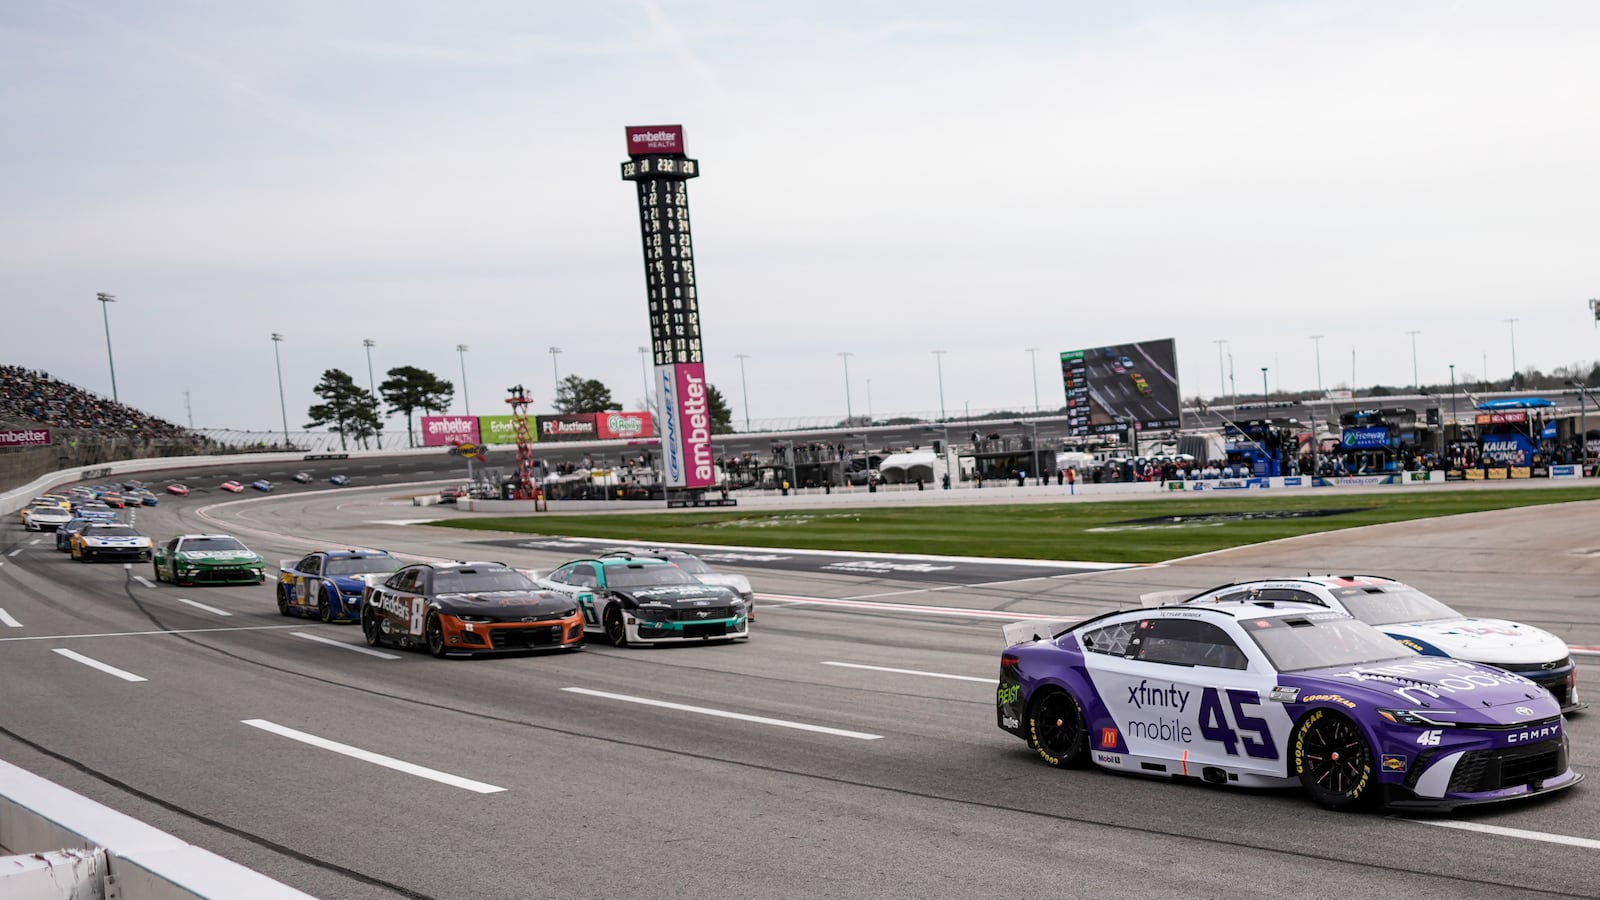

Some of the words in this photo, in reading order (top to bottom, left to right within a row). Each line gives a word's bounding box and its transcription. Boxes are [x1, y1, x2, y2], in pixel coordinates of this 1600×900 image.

[632, 131, 676, 142] ambetter
[624, 162, 635, 176] 232
[658, 158, 673, 172] 232
[666, 182, 670, 191] 1
[679, 181, 685, 194] 2
[665, 194, 672, 203] 2
[675, 193, 686, 206] 22
[667, 208, 673, 218] 3
[677, 207, 688, 219] 21
[668, 219, 674, 230] 4
[670, 234, 676, 244] 5
[679, 234, 690, 246] 23
[681, 246, 691, 258] 24
[672, 261, 678, 270] 7
[682, 260, 693, 272] 45
[688, 272, 694, 284] 5
[674, 313, 683, 323] 11
[689, 312, 697, 324] 12
[675, 326, 684, 335] 12
[693, 325, 698, 336] 9
[429, 418, 472, 434] ambetter
[559, 421, 592, 432] Auctions
[662, 370, 679, 471] BENNETT
[685, 374, 711, 480] ambetter
[0, 430, 47, 442] mbetter
[1483, 441, 1518, 451] KAULIG
[309, 579, 318, 606] 9
[370, 589, 409, 621] Cheddar's
[410, 598, 424, 636] 8
[1128, 680, 1190, 712] xfinity
[1303, 694, 1356, 709] GOODYEAR
[1129, 717, 1192, 743] mobile
[1199, 687, 1279, 760] 45
[1417, 730, 1443, 745] 45
[1507, 725, 1559, 743] CAMRY
[1295, 710, 1323, 774] GOODYEAR
[1098, 754, 1114, 763] Mobil
[1352, 764, 1370, 798] EAGLE
